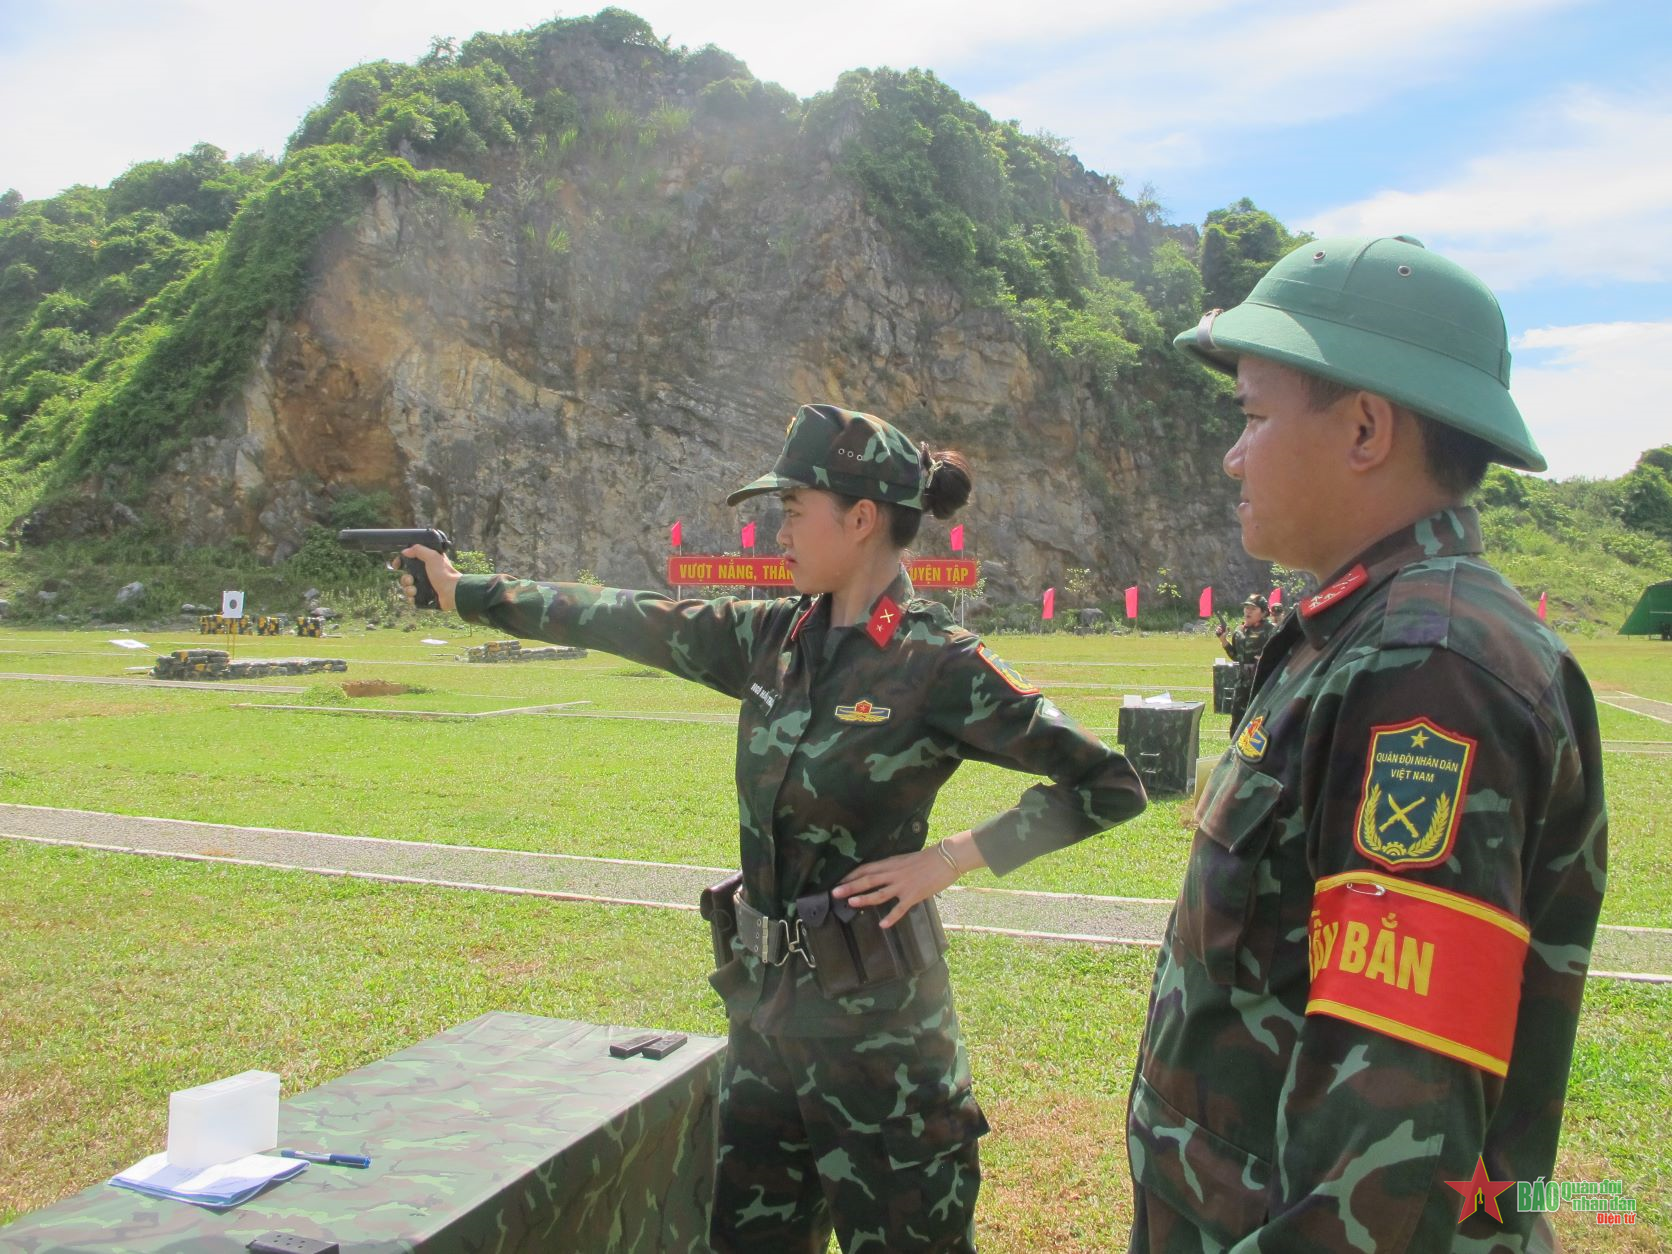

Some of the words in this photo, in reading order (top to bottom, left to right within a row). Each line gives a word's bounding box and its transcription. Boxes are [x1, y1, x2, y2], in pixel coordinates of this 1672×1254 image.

[679, 563, 713, 582] VƯỢT
[718, 559, 757, 581] NẮNG,
[946, 564, 969, 584] TẬP
[1376, 751, 1399, 763] QUÂN
[1399, 752, 1415, 766] ĐỘI
[1415, 755, 1438, 768] NHÂN
[1439, 758, 1459, 773] DÂN
[1391, 768, 1412, 781] VIỆT
[1413, 771, 1435, 783] NAM
[1339, 912, 1435, 996] BẮN
